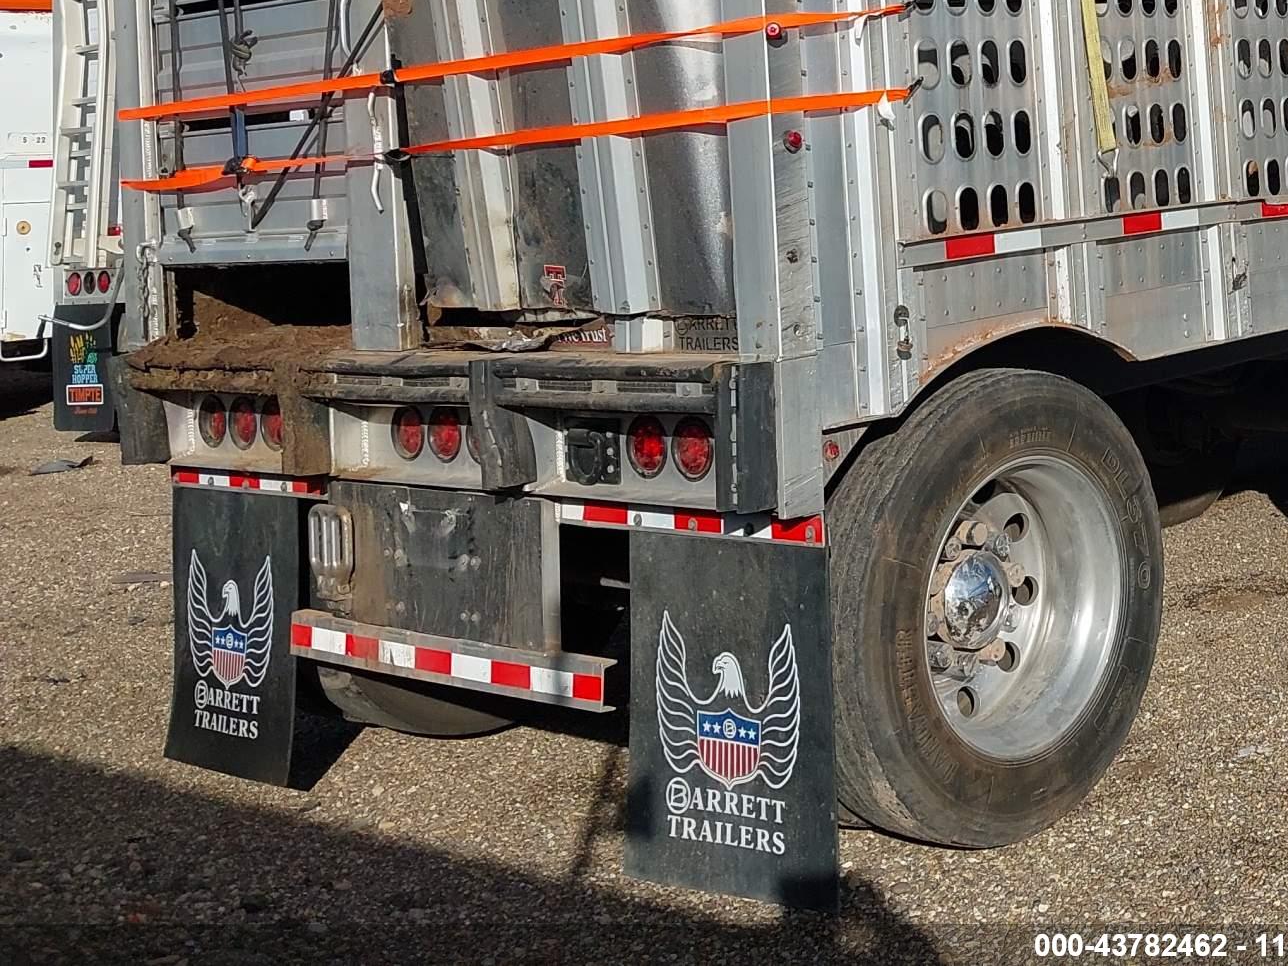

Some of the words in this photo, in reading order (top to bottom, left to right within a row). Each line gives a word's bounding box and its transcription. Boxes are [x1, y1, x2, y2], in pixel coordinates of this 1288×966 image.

[679, 336, 739, 351] TRAILERS
[71, 374, 99, 384] HOPPER
[73, 364, 97, 375] SUPER
[69, 387, 102, 403] TIMPTE
[194, 679, 261, 715] BARRETT
[194, 709, 259, 739] TRAILERS
[665, 776, 786, 824] BARRETT
[667, 814, 786, 855] TRAILERS
